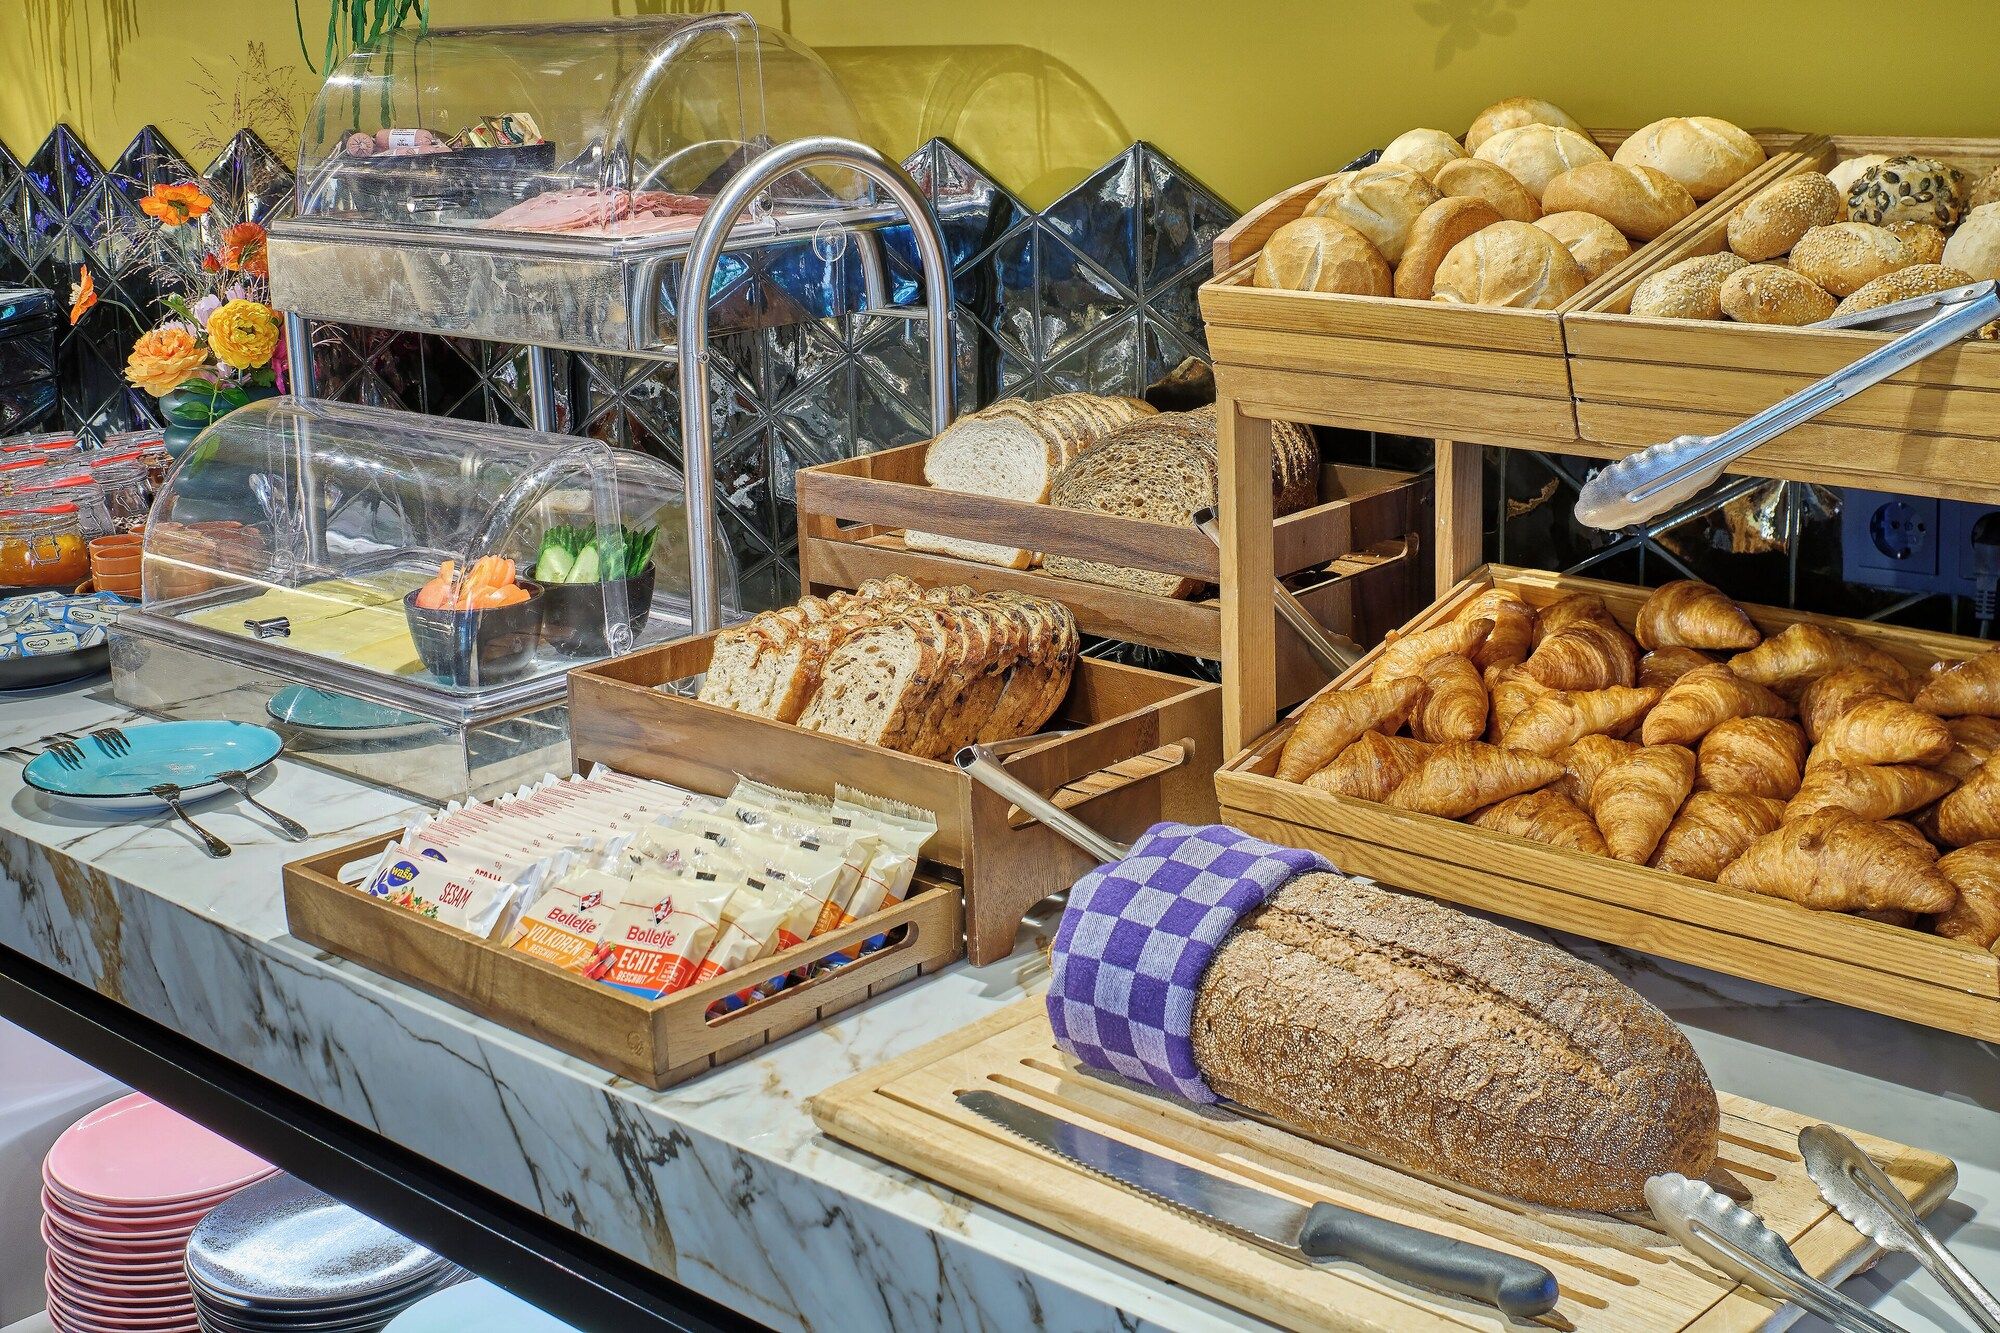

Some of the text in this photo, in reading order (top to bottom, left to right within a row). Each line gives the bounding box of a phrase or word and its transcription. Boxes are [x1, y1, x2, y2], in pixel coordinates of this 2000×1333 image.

[439, 882, 473, 910] SESAM
[546, 906, 597, 934] Bolletje
[526, 924, 587, 957] VOLKOREN
[626, 924, 676, 949] Bolletje
[528, 943, 560, 961] BESCHUIT
[617, 948, 663, 974] ECHTE
[615, 970, 648, 985] BESCHUIT
